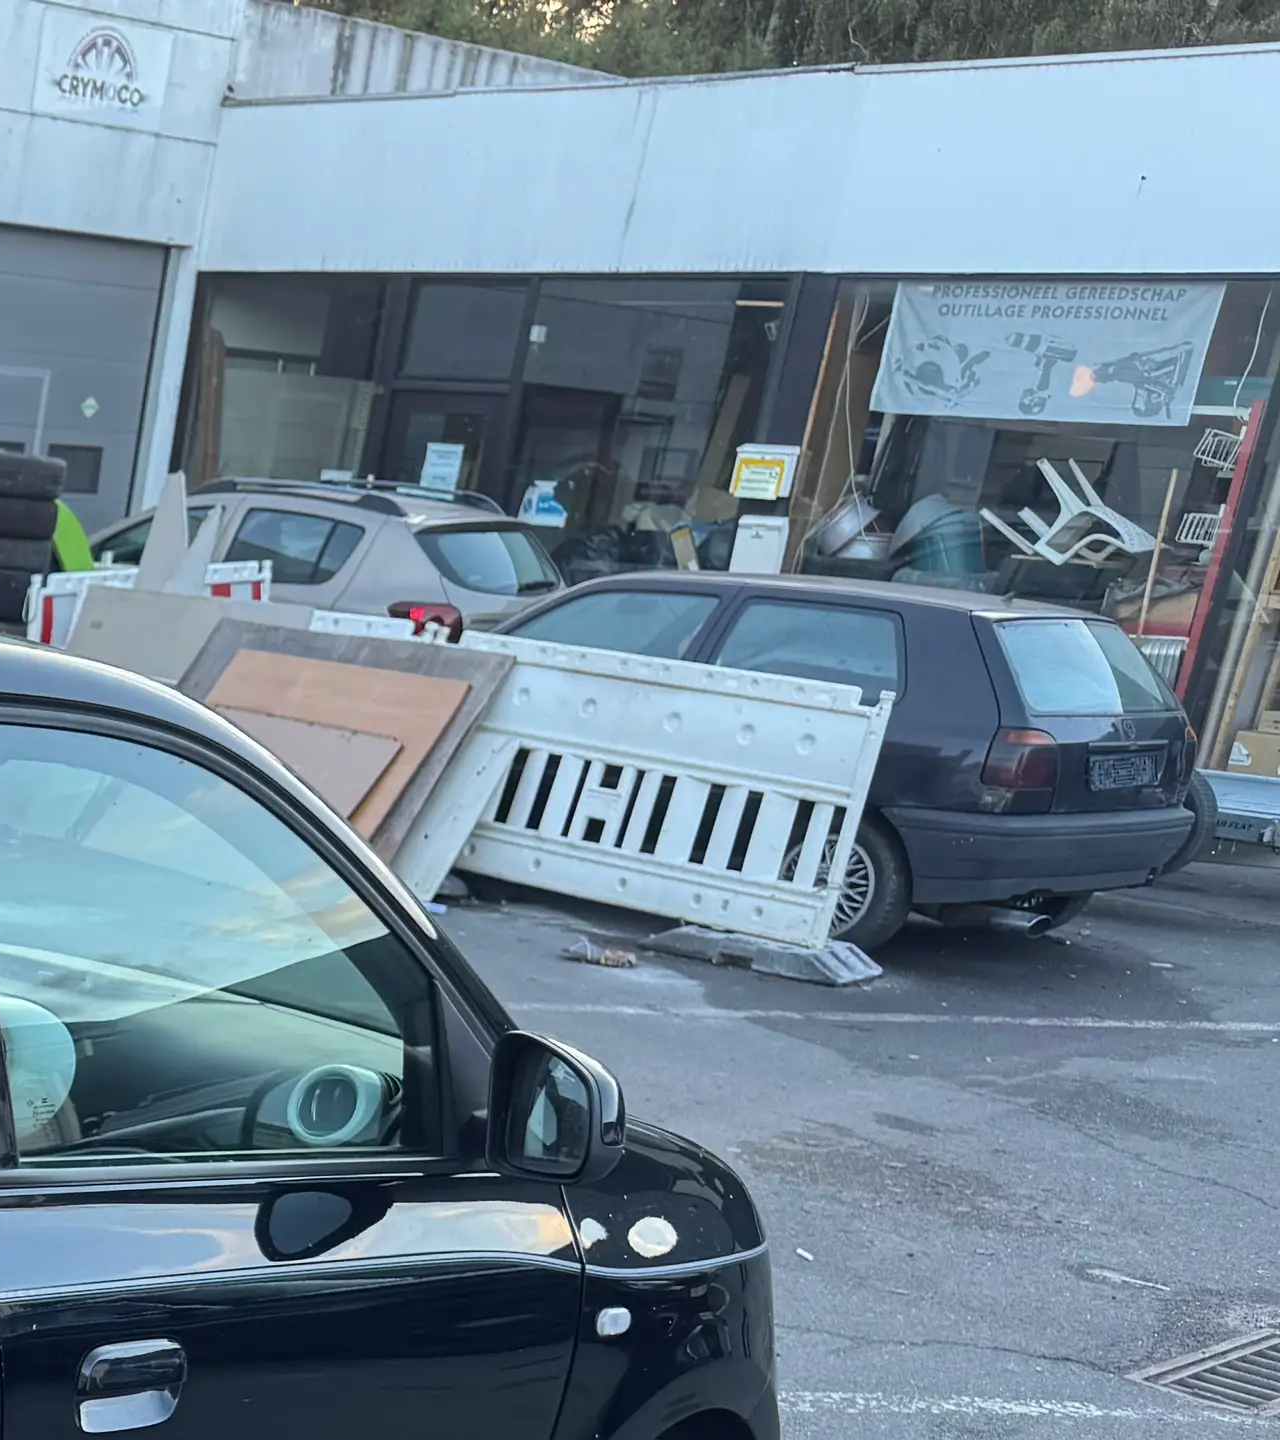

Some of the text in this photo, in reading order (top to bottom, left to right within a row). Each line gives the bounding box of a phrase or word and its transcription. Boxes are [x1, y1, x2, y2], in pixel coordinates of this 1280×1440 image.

[932, 284, 1187, 302] PROFESSIONEEL GEREEDSCHAP
[938, 303, 1169, 321] OUTILLAGE PROFESSIONNEL
